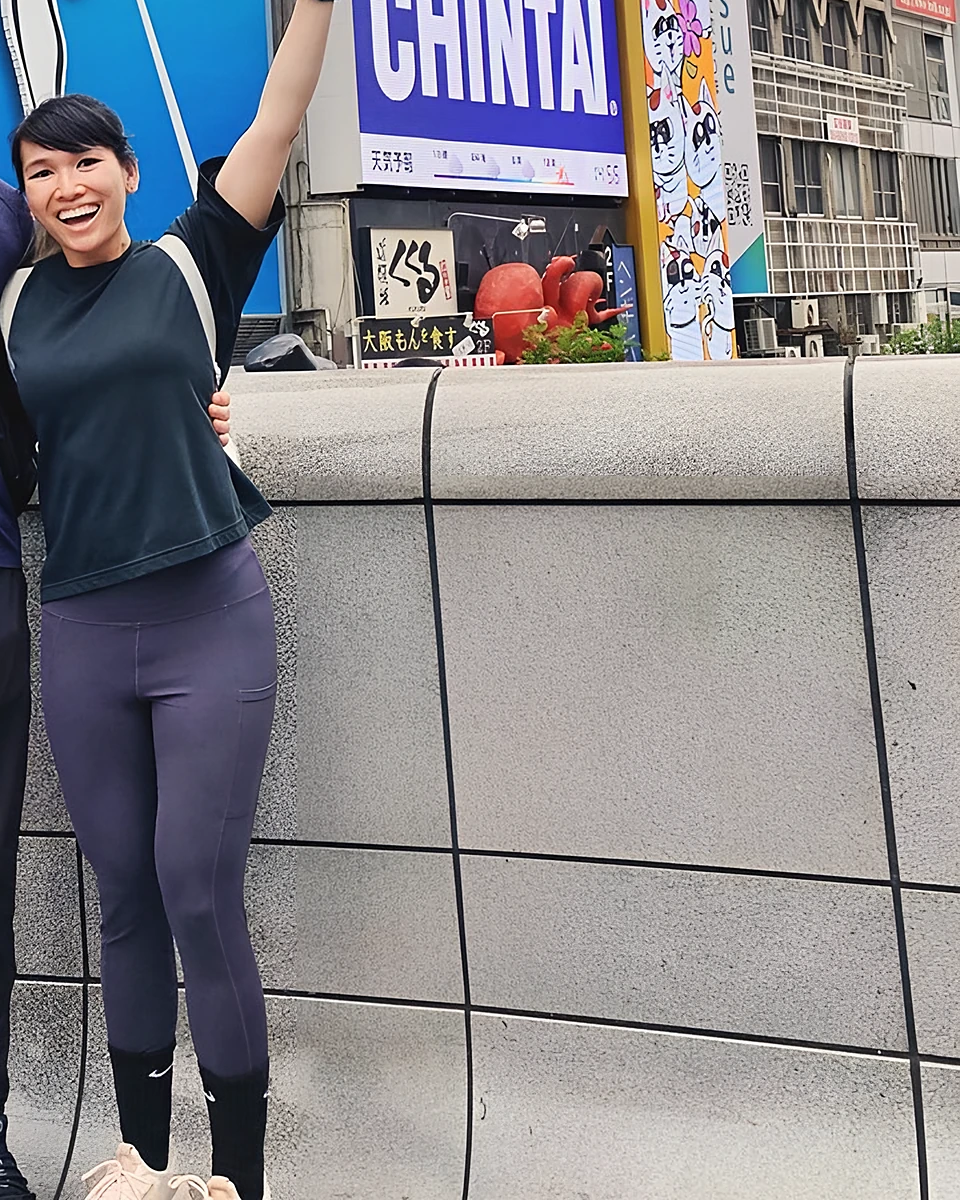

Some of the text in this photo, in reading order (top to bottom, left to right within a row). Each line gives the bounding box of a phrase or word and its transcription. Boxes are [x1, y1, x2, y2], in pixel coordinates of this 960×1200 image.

[388, 238, 441, 304] くくる
[362, 325, 457, 352] 大阪もんを食す
[476, 339, 492, 354] 2F
